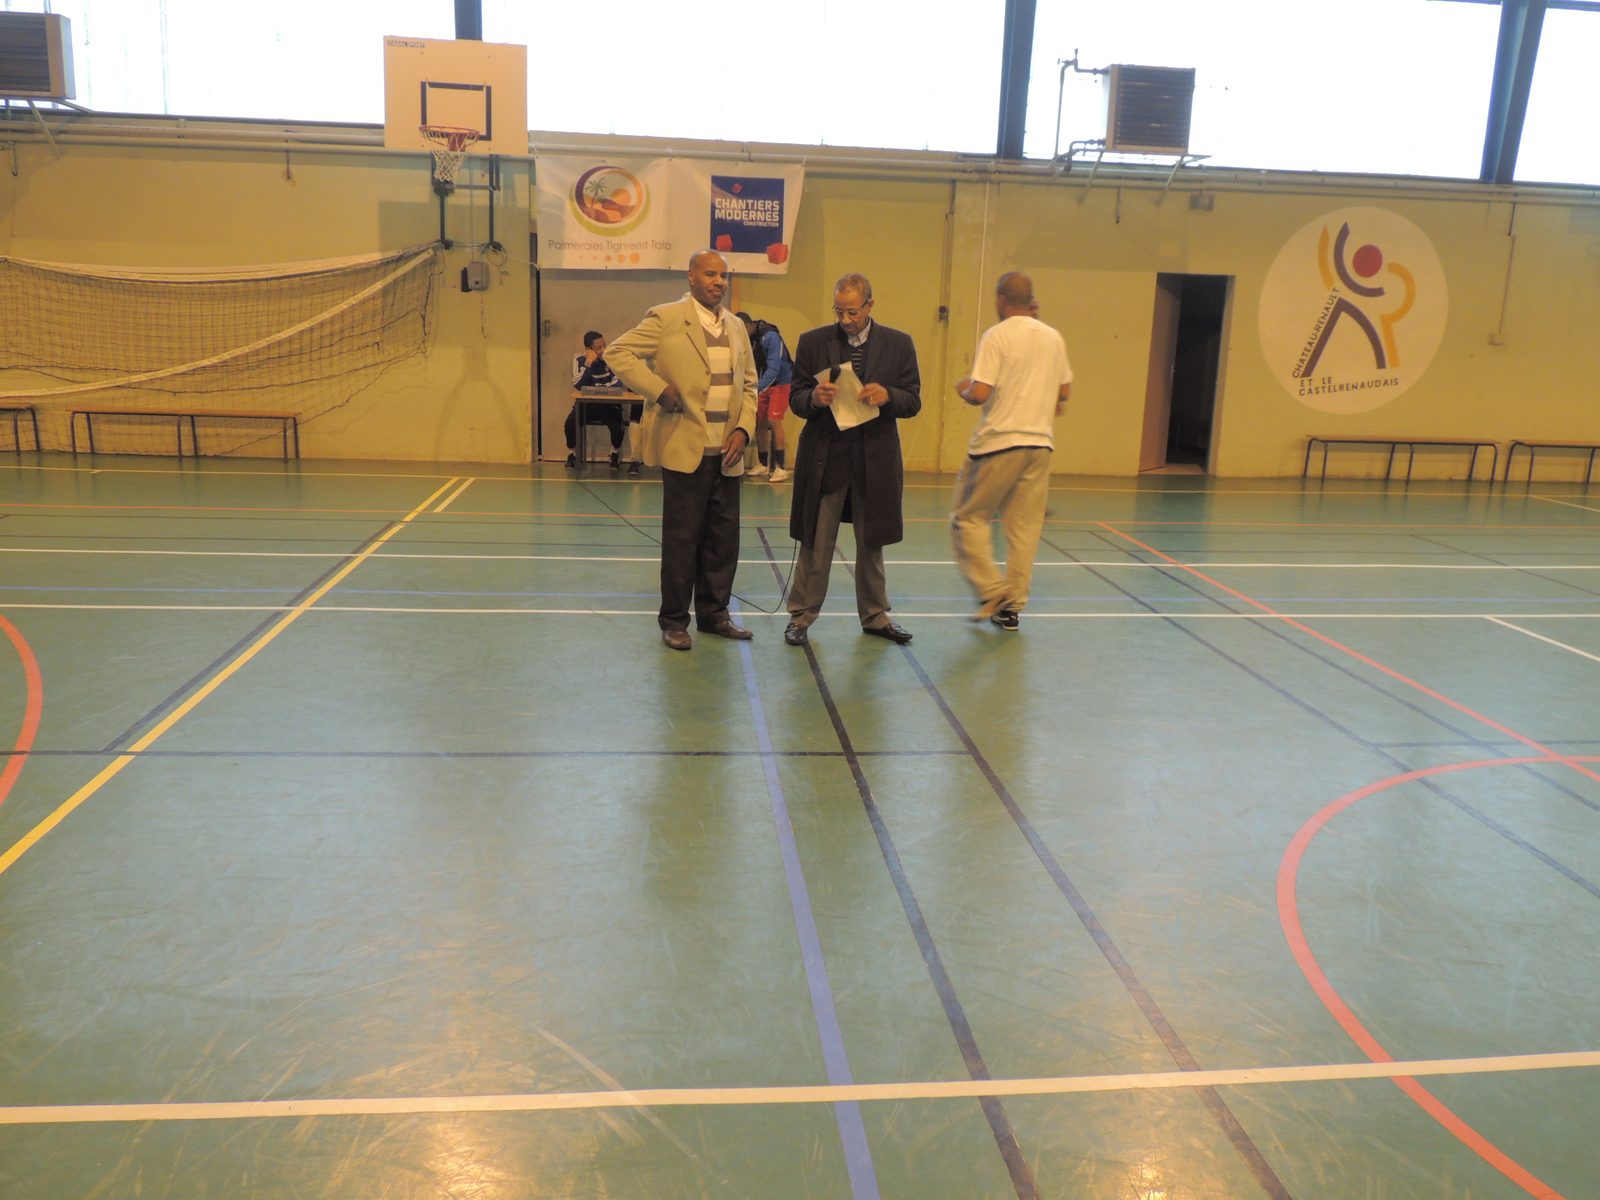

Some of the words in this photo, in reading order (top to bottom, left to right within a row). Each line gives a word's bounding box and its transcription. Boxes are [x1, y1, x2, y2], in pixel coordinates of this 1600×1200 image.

[715, 199, 780, 211] CHANTIERS
[715, 209, 780, 222] MODERNES
[547, 239, 604, 251] Palmeraies
[1291, 287, 1340, 378] CHATEAU-RENAULT
[1298, 377, 1400, 397] CASTELRENAUDAIS
[1300, 378, 1313, 388] ET
[1321, 376, 1333, 385] LE
